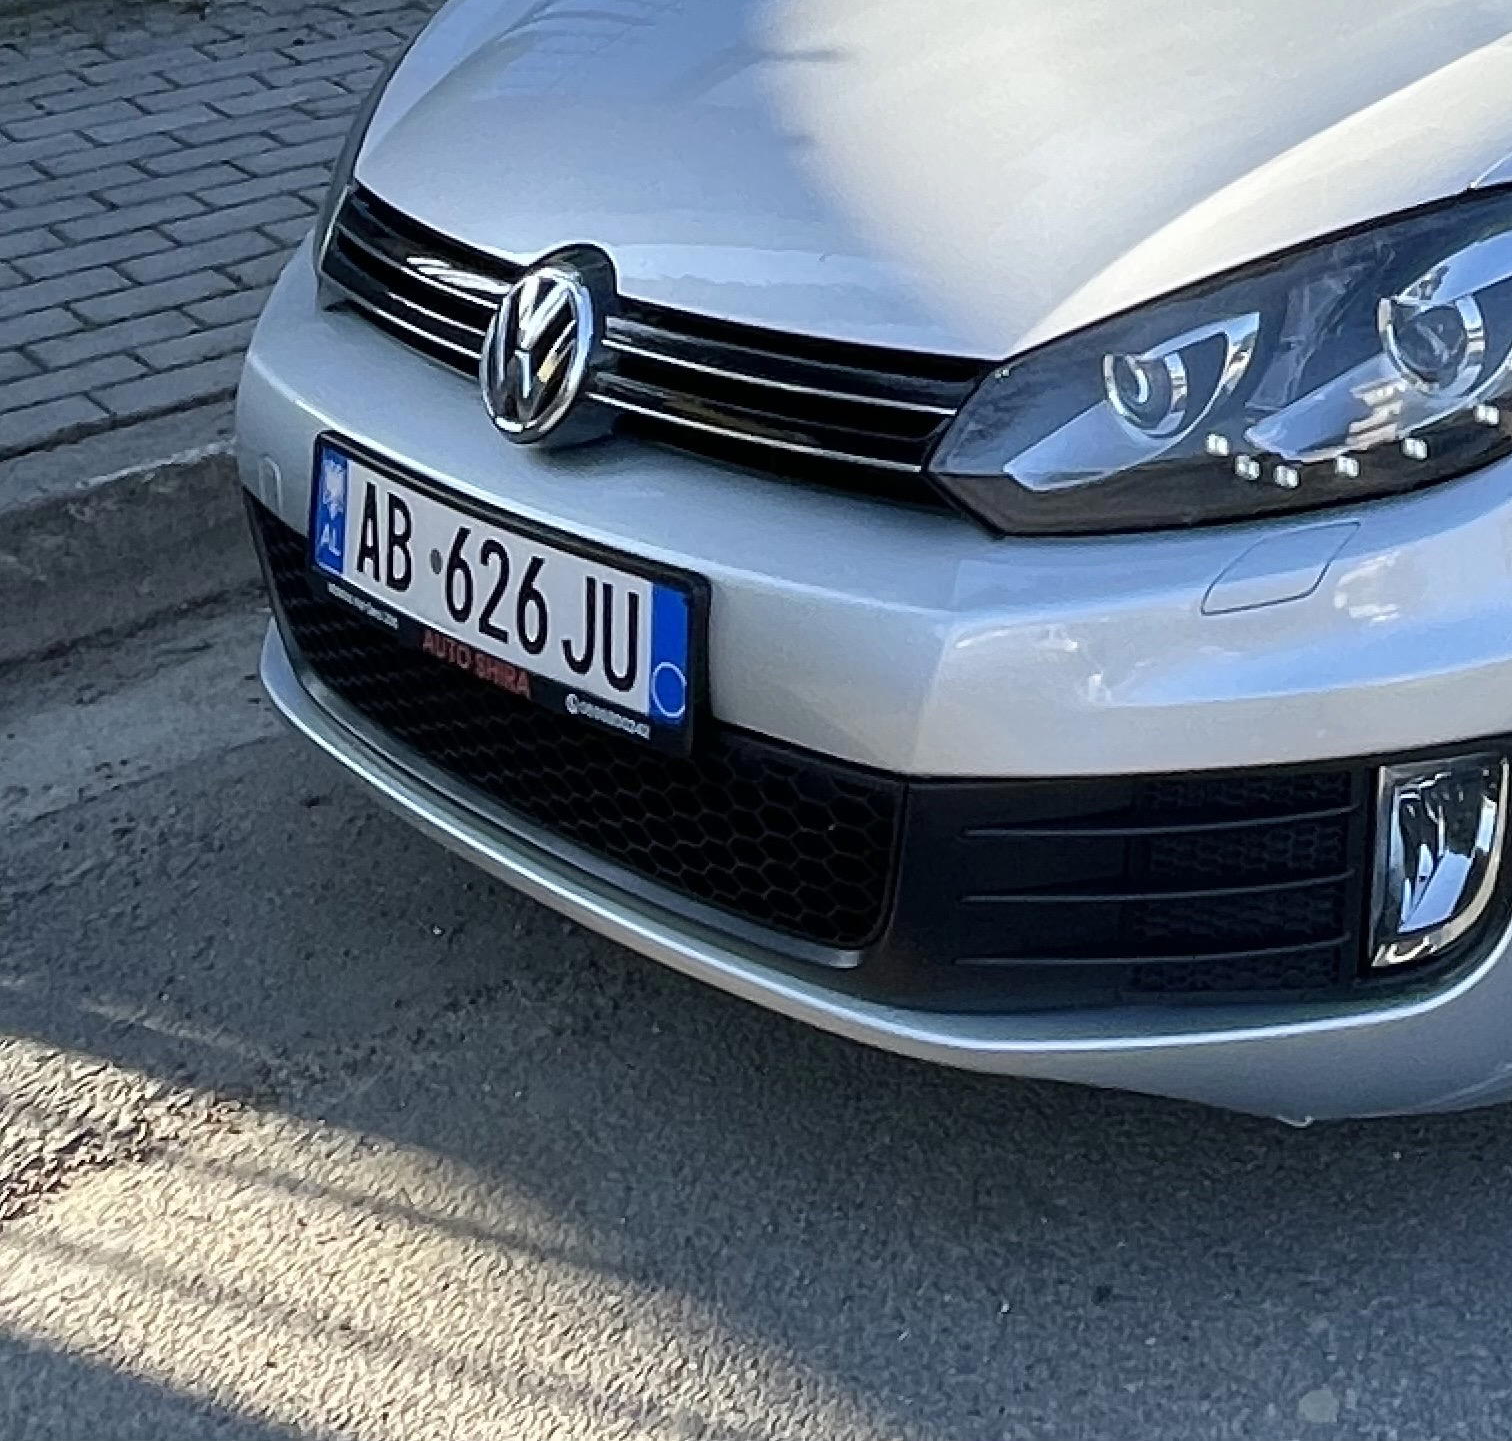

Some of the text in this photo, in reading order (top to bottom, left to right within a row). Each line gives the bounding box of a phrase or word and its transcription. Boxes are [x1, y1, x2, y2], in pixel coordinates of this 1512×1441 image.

[356, 481, 414, 592] AB
[445, 526, 549, 655] 626
[562, 576, 640, 693] JU
